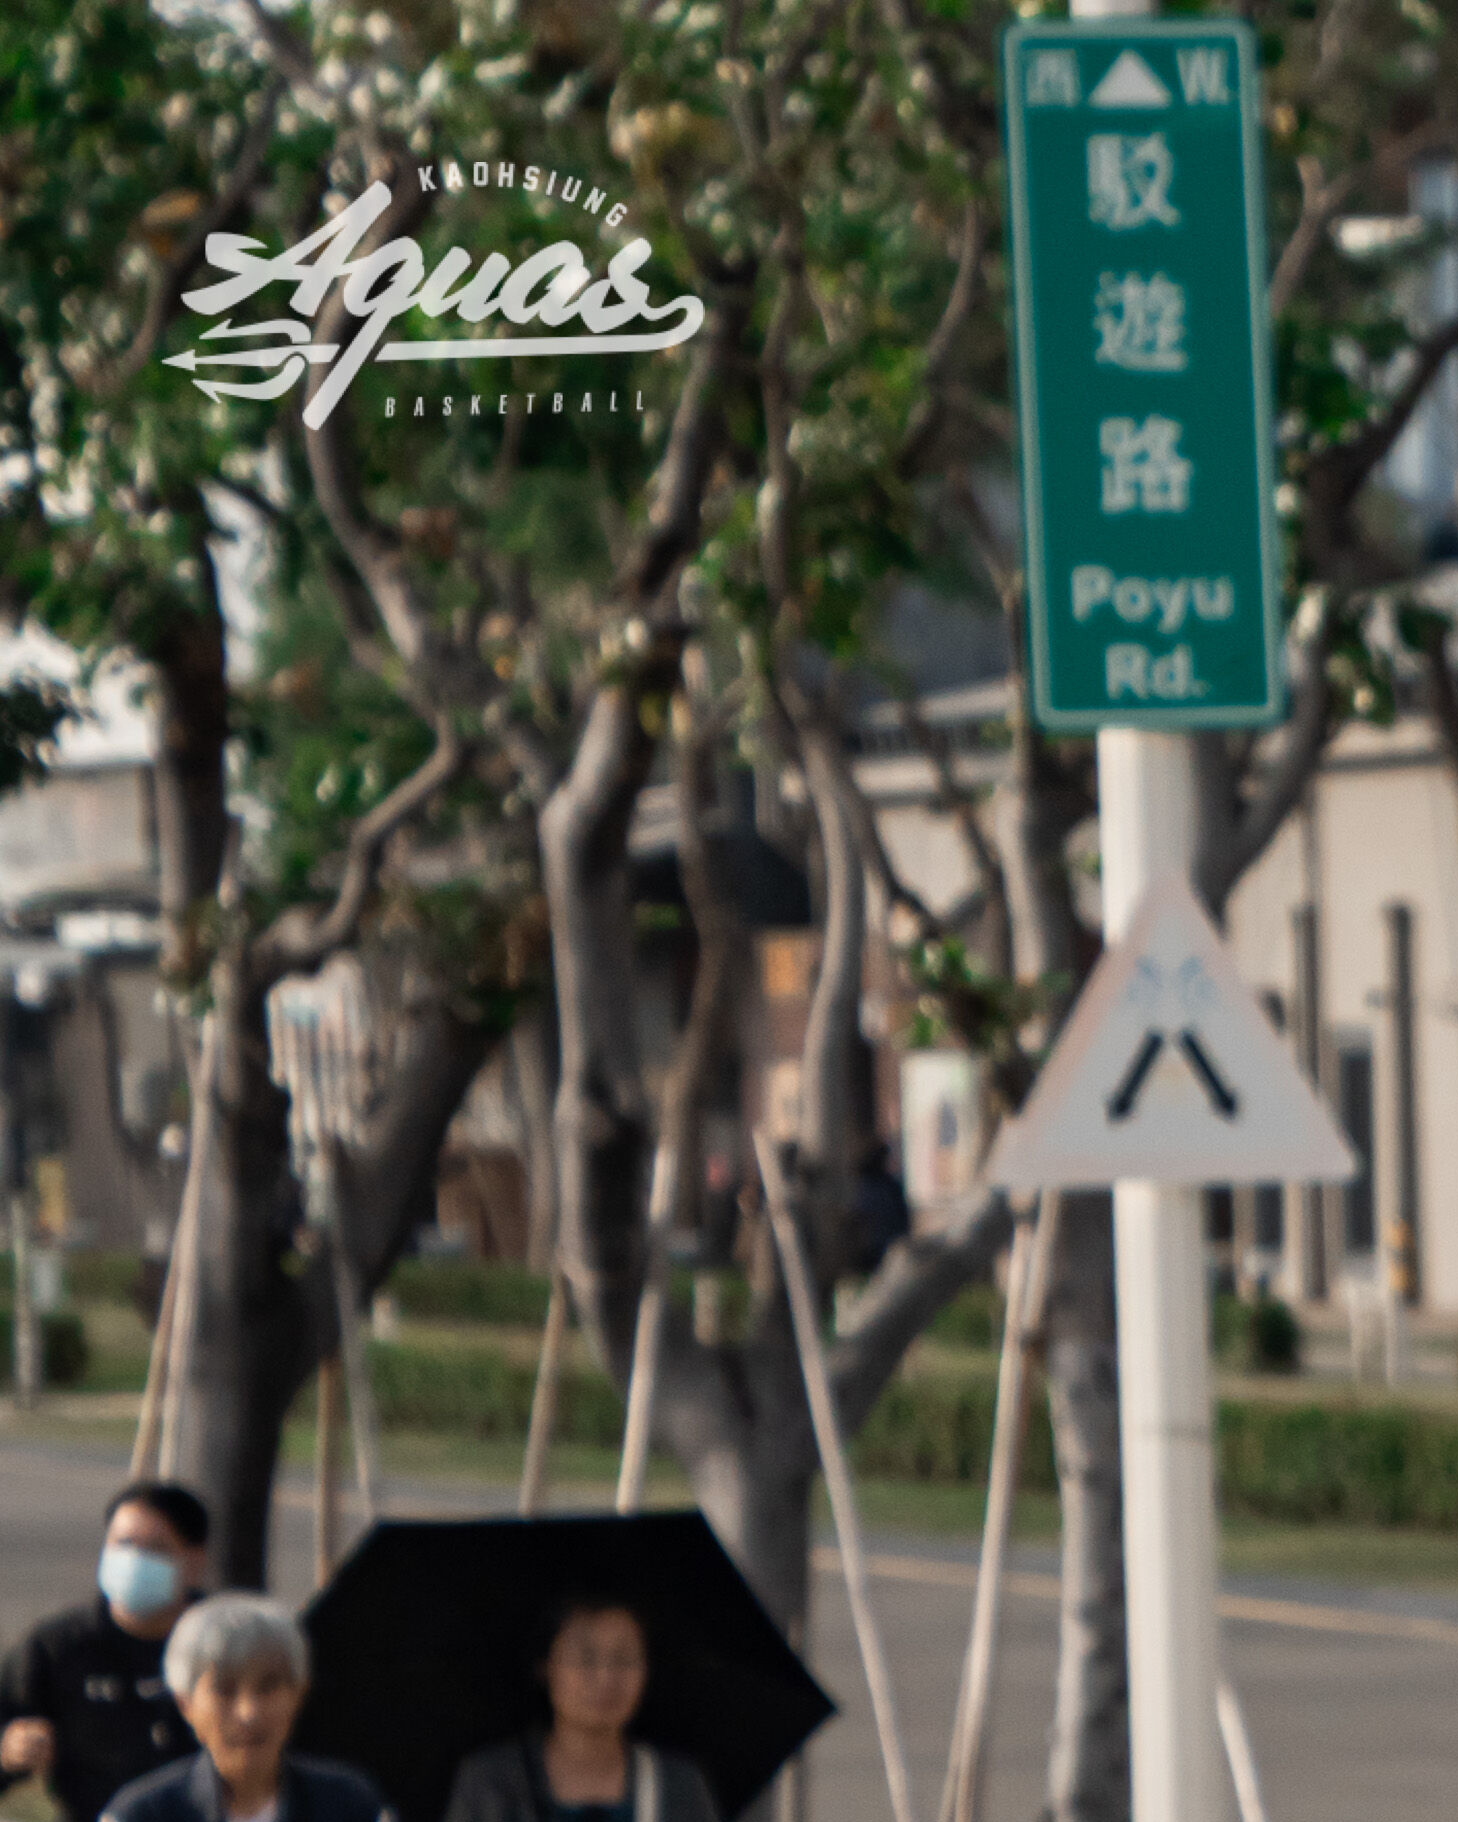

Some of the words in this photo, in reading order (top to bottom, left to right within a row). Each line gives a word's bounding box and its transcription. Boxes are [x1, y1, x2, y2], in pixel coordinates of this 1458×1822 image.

[1176, 48, 1230, 105] W
[1070, 563, 1236, 634] Poyu
[1105, 641, 1211, 700] Rd.
